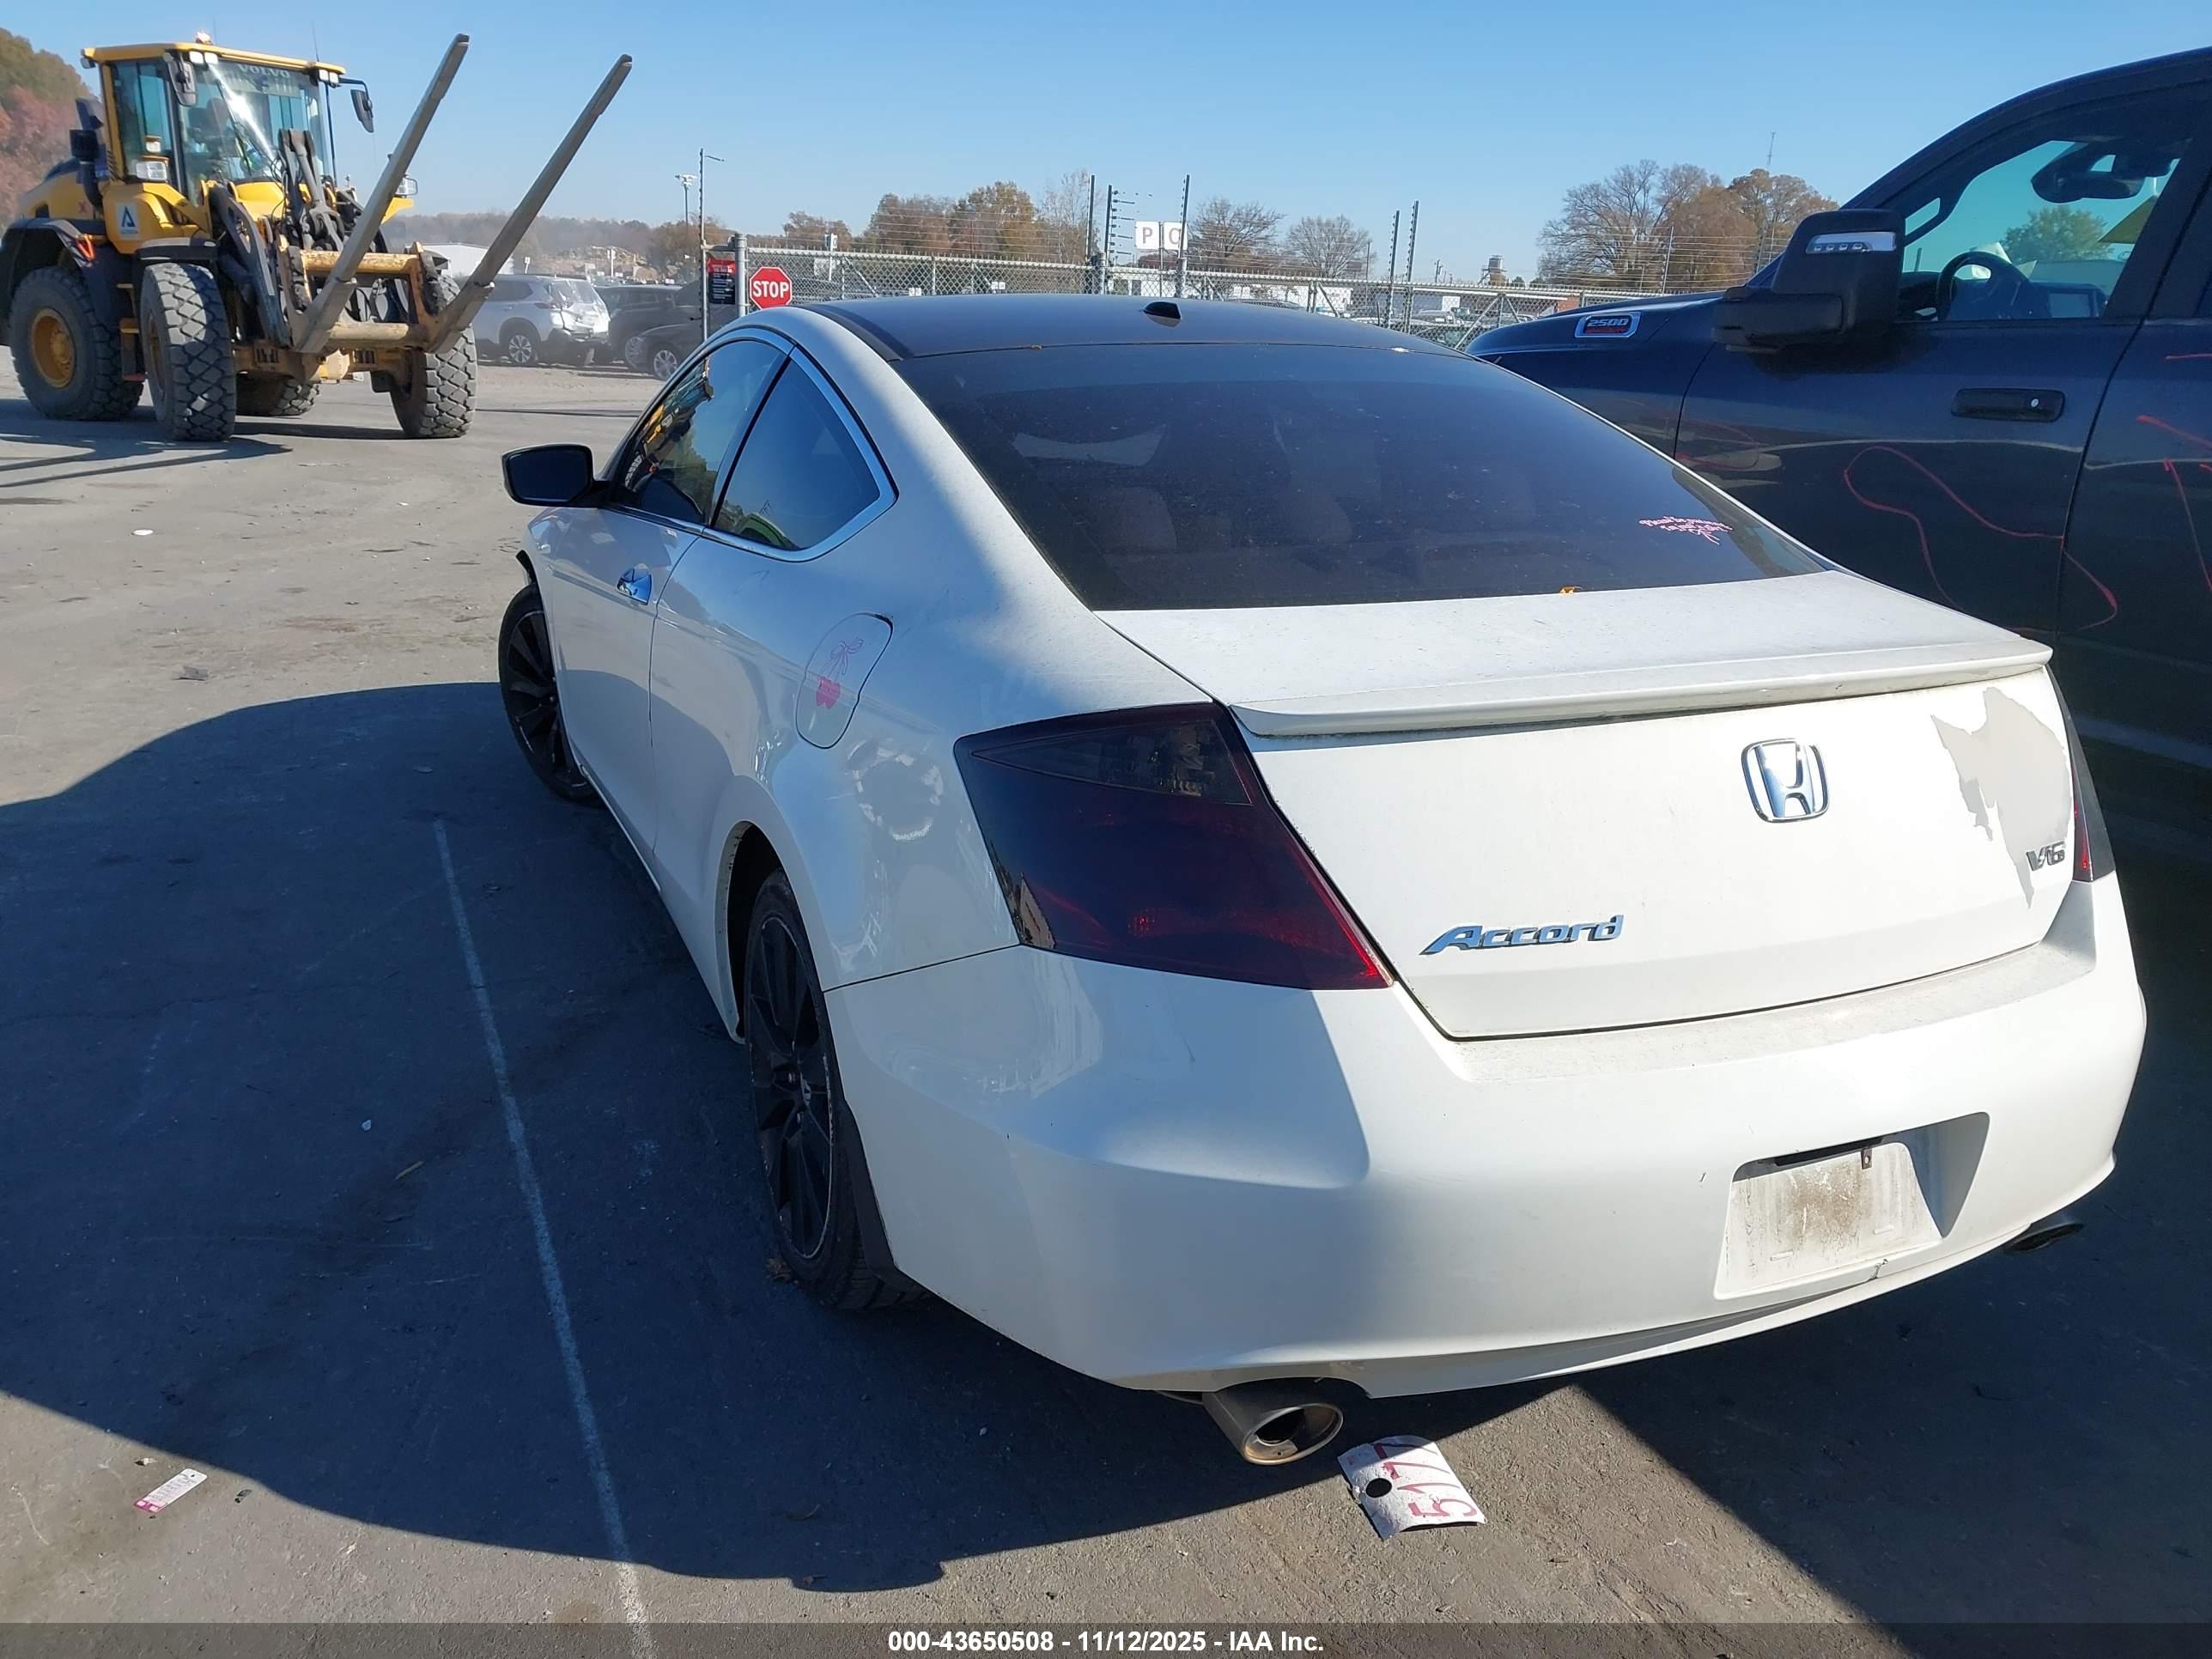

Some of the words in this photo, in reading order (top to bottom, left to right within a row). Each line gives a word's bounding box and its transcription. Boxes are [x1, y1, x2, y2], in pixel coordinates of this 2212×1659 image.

[237, 64, 290, 79] VOLVO
[1142, 226, 1153, 245] P
[752, 280, 789, 299] STOP
[1586, 318, 1630, 327] 2500
[2026, 840, 2065, 872] V6
[1419, 914, 1625, 956] Accord
